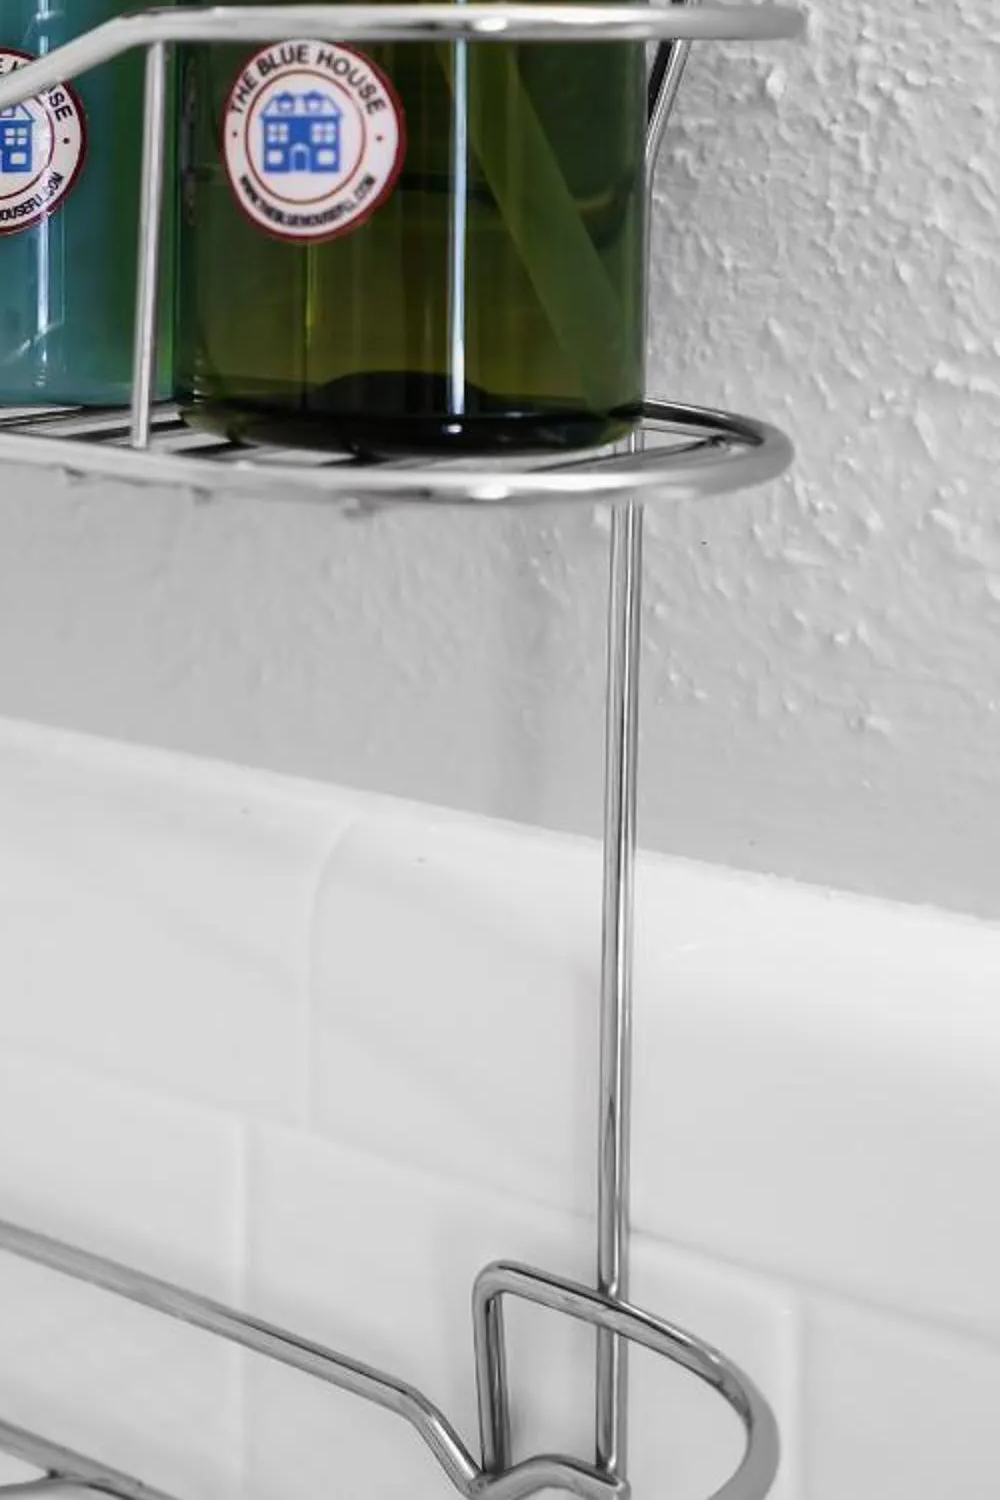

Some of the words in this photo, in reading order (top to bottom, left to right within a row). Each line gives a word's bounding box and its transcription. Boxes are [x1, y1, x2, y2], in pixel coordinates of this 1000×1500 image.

[231, 72, 259, 114] THE
[256, 45, 309, 77] BLUE
[316, 50, 387, 115] HOUSE
